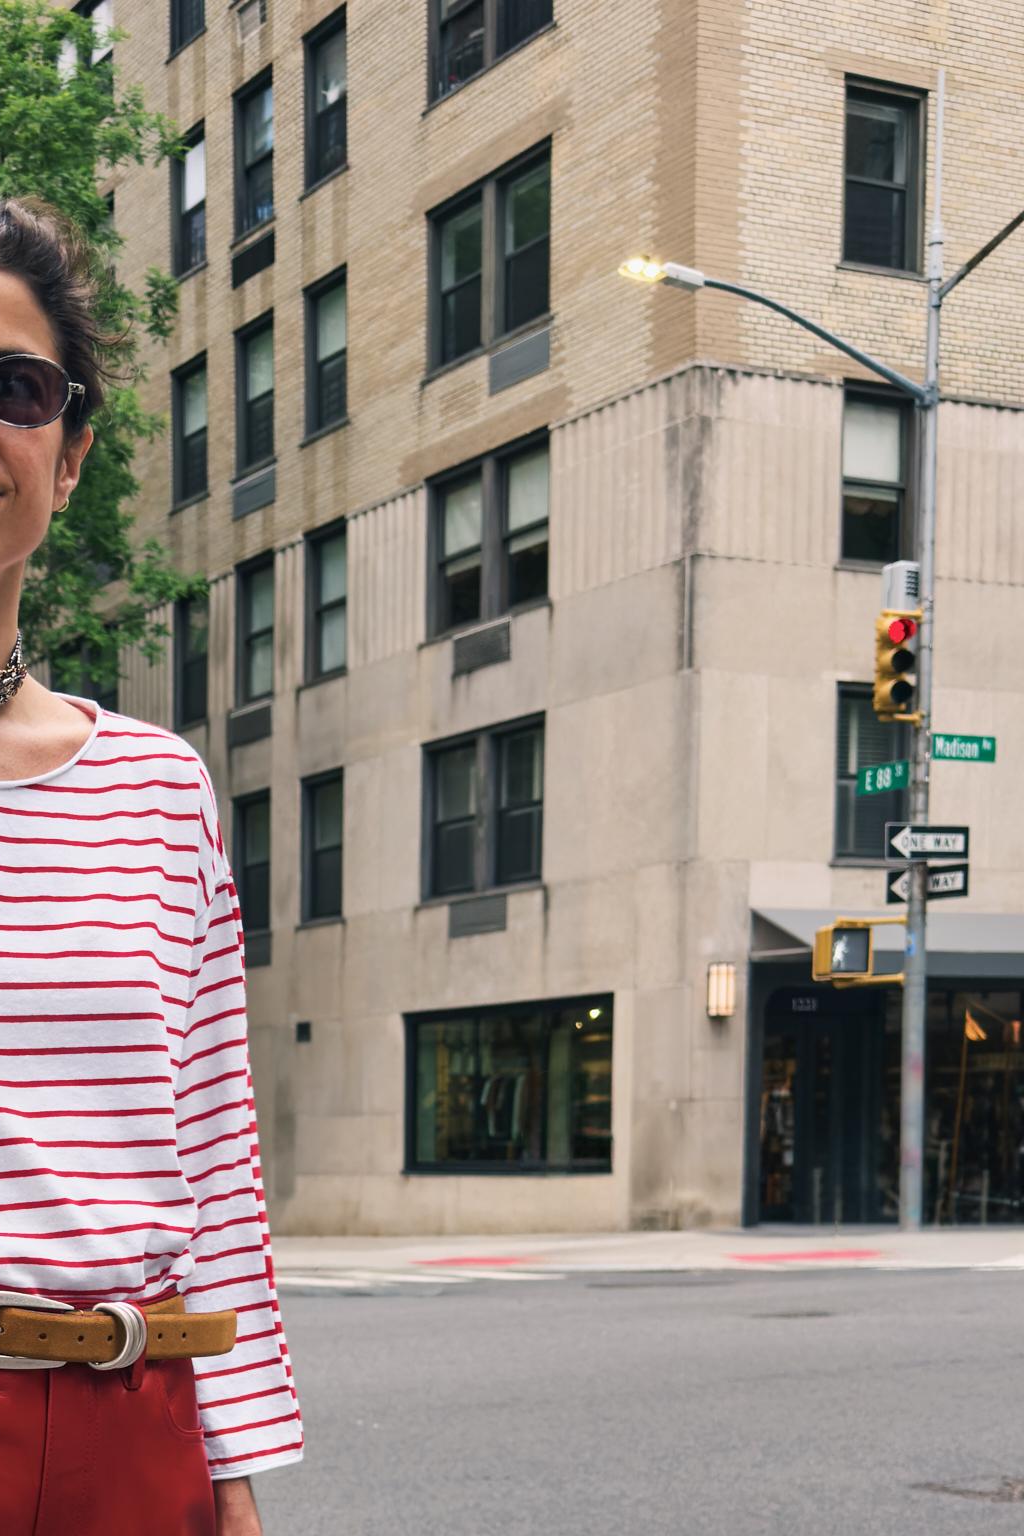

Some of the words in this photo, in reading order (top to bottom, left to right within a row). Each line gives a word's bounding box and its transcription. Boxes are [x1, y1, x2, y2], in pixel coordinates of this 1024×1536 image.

[935, 737, 979, 758] Madison
[865, 769, 873, 791] E
[901, 835, 927, 851] ONE
[933, 836, 957, 849] WAY
[931, 875, 956, 889] WAY
